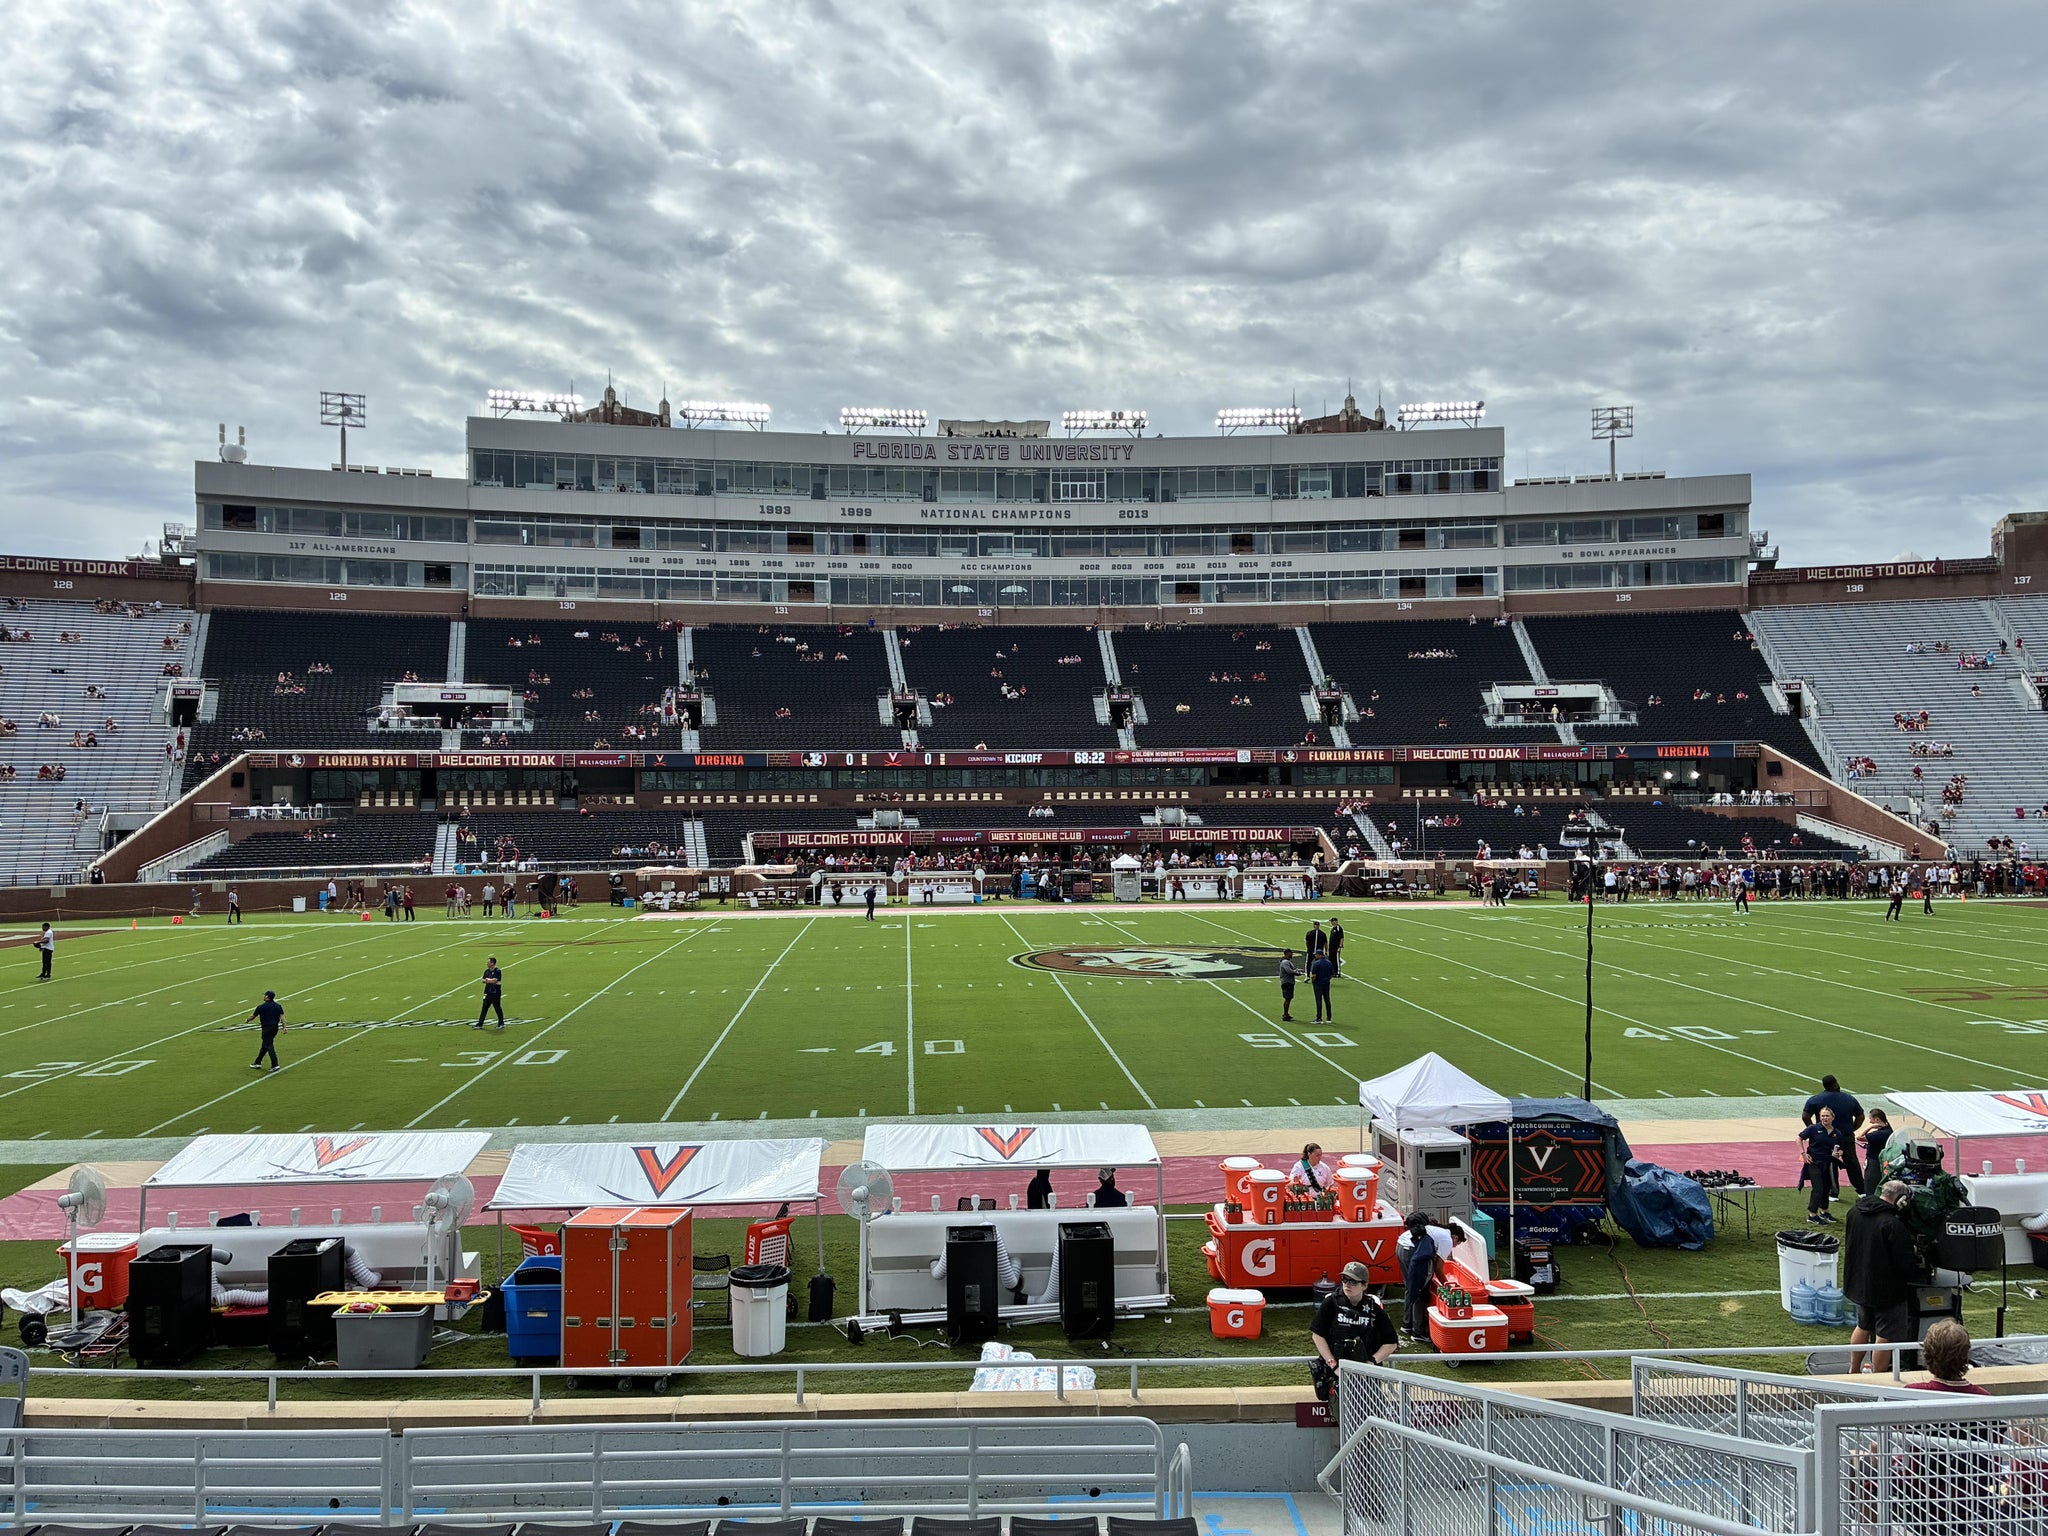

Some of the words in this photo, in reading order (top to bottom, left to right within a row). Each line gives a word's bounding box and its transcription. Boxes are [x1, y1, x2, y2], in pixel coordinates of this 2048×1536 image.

[853, 442, 937, 460] FLORIDA
[948, 444, 1010, 460] STATE
[1020, 444, 1134, 461] UNIVERSITY
[759, 504, 792, 516] 1993
[840, 507, 872, 517] 1999
[920, 509, 986, 519] NATIONAL
[992, 509, 1072, 520] CHAMPIONS
[1118, 510, 1149, 519] 2013
[289, 542, 306, 550] 117
[312, 542, 396, 554] ALL-AMERICANS
[1580, 550, 1606, 558] BOWL
[1608, 548, 1676, 556] APPEARANCES
[62, 560, 82, 572] TO
[87, 562, 128, 574] DOAK
[1806, 566, 1873, 580] WELCOME
[1876, 565, 1894, 576] TO
[1898, 562, 1936, 576] DOAK
[53, 580, 73, 589] 128
[2014, 576, 2032, 584] 137
[1846, 584, 1864, 593] 136
[329, 592, 347, 601] 129
[1615, 594, 1632, 602] 135
[559, 602, 576, 610] 130
[774, 606, 788, 615] 131
[1188, 607, 1204, 615] 133
[1397, 602, 1412, 610] 134
[978, 608, 992, 617] 132
[1309, 750, 1350, 761] FLORIDA
[1354, 750, 1384, 760] STATE
[1413, 749, 1469, 759] WELCOME
[1471, 749, 1486, 759] TO
[1489, 748, 1520, 759] DOAK
[1657, 746, 1710, 757] VIRGINIA
[318, 756, 368, 766] FLORIDA
[372, 756, 407, 766] STATE
[440, 755, 500, 766] WELCOME
[504, 755, 519, 766] TO
[522, 755, 556, 766] DOAK
[694, 754, 744, 766] VIRGINIA
[846, 754, 854, 766] 0
[924, 753, 932, 765] 0
[1004, 754, 1042, 764] KICKOFF
[1074, 752, 1105, 764] 68:22
[788, 834, 848, 845] WELCOME
[851, 834, 867, 844] TO
[870, 832, 904, 844] DOAK
[992, 832, 1015, 841] WEST
[1018, 832, 1058, 840] SIDELINE
[1060, 832, 1082, 840] CLUB
[1170, 830, 1230, 841] WELCOME
[1232, 830, 1248, 840] TO
[1250, 829, 1282, 840] DOAK
[1237, 1032, 1359, 1048] 50
[1623, 1026, 1740, 1042] 40
[855, 1038, 966, 1056] 40
[440, 1049, 571, 1068] 30
[1, 1060, 157, 1078] 20
[631, 1145, 705, 1199] V
[1237, 1177, 1250, 1194] G
[1262, 1186, 1278, 1203] G
[1352, 1184, 1368, 1200] G
[1948, 1223, 2002, 1236] CHAPMAN
[1361, 1240, 1384, 1261] V
[1241, 1238, 1276, 1277] G
[77, 1262, 102, 1294] G
[1458, 1308, 1464, 1317] G
[1226, 1310, 1244, 1328] G
[1468, 1330, 1486, 1349] G
[1312, 1406, 1326, 1416] NO
